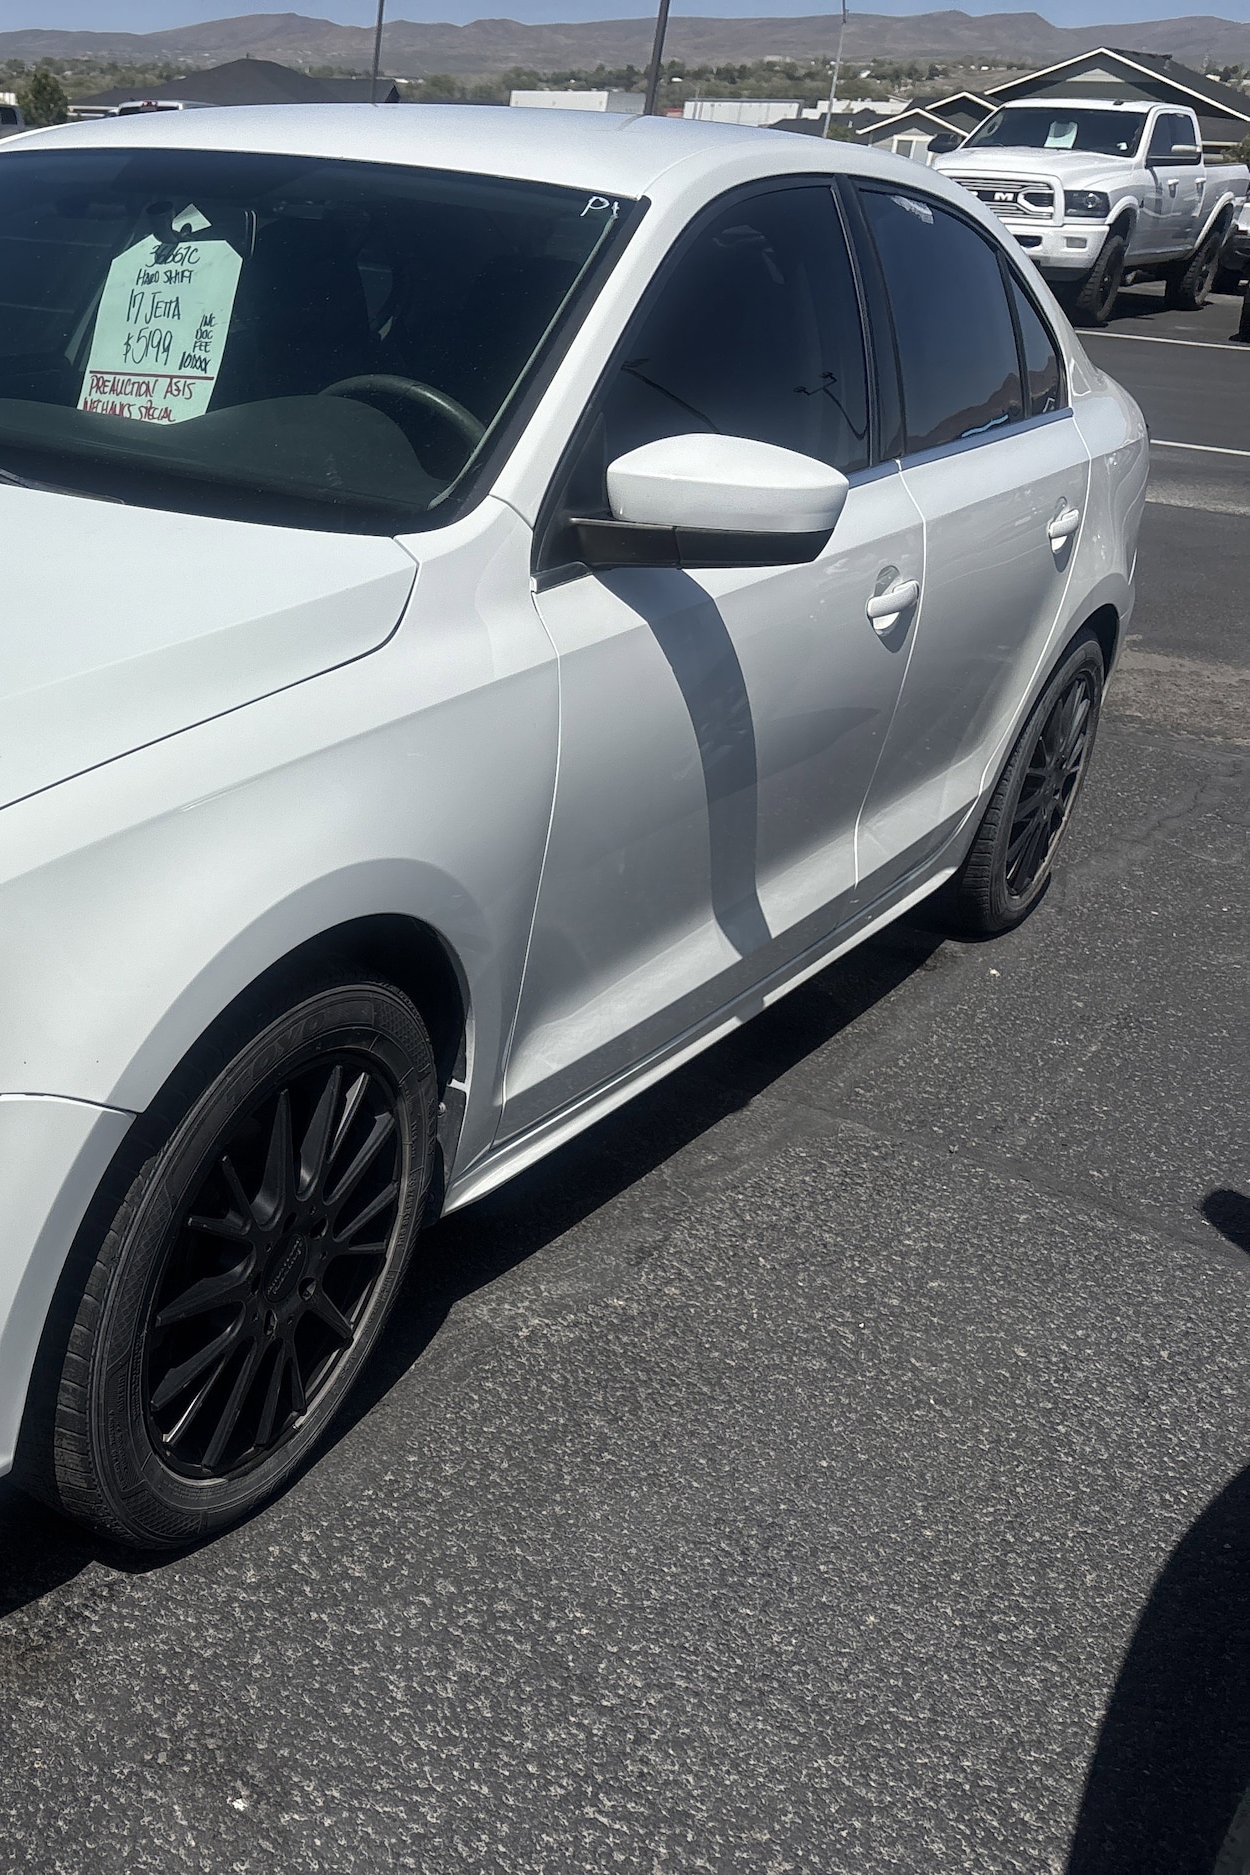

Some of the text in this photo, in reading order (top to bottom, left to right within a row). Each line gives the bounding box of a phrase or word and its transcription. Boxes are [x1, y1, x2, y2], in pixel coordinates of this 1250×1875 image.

[163, 269, 194, 284] SHIFT
[127, 288, 181, 324] 17 JETTA
[195, 328, 214, 340] DOC
[123, 327, 173, 366] $5199
[193, 340, 212, 353] FEE
